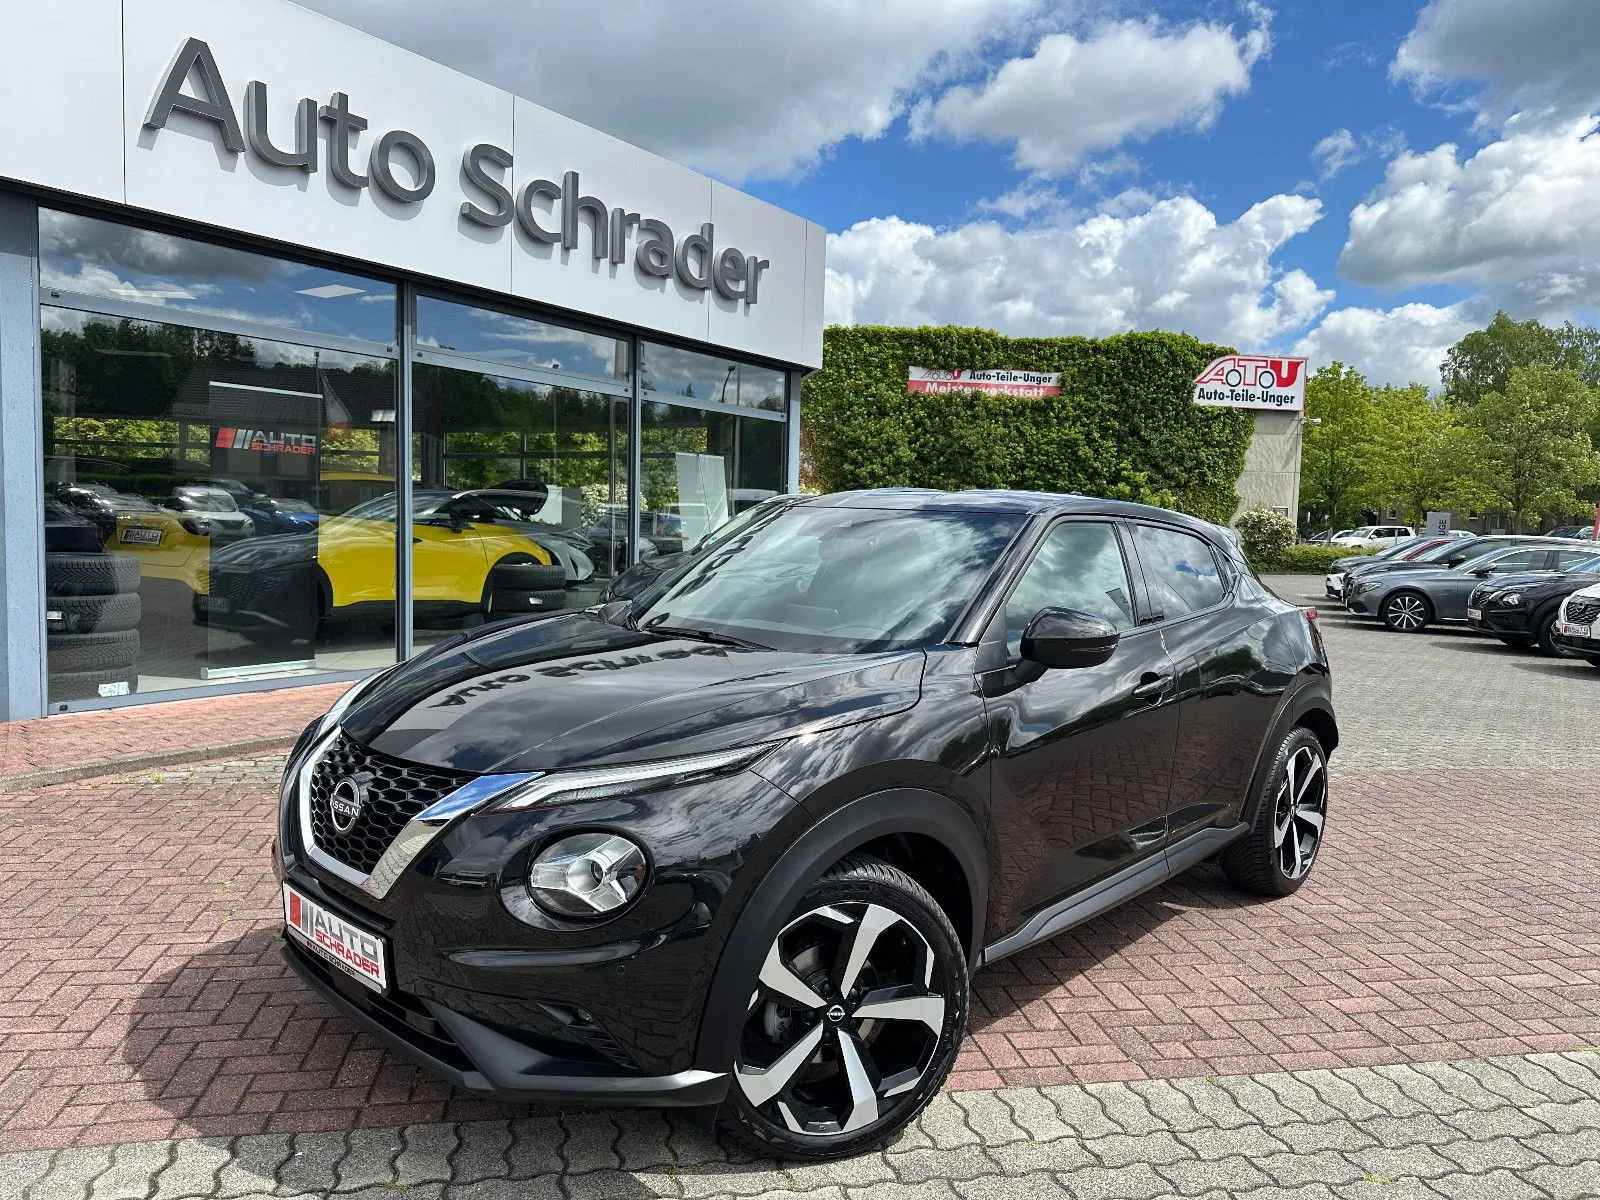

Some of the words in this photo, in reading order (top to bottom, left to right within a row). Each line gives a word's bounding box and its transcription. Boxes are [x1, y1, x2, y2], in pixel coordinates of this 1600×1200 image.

[144, 37, 436, 203] Auto
[460, 143, 769, 305] Schrader
[969, 371, 1052, 384] Auto-Teile-Unger
[925, 382, 1045, 397] Meisteekstatt
[1198, 388, 1295, 407] Auto-Teile-Unger
[252, 430, 317, 447] AUTO
[251, 442, 316, 455] SCHRADER
[330, 797, 360, 817] ISSAN
[314, 909, 379, 963] AUTO
[314, 927, 380, 978] SCHRADER
